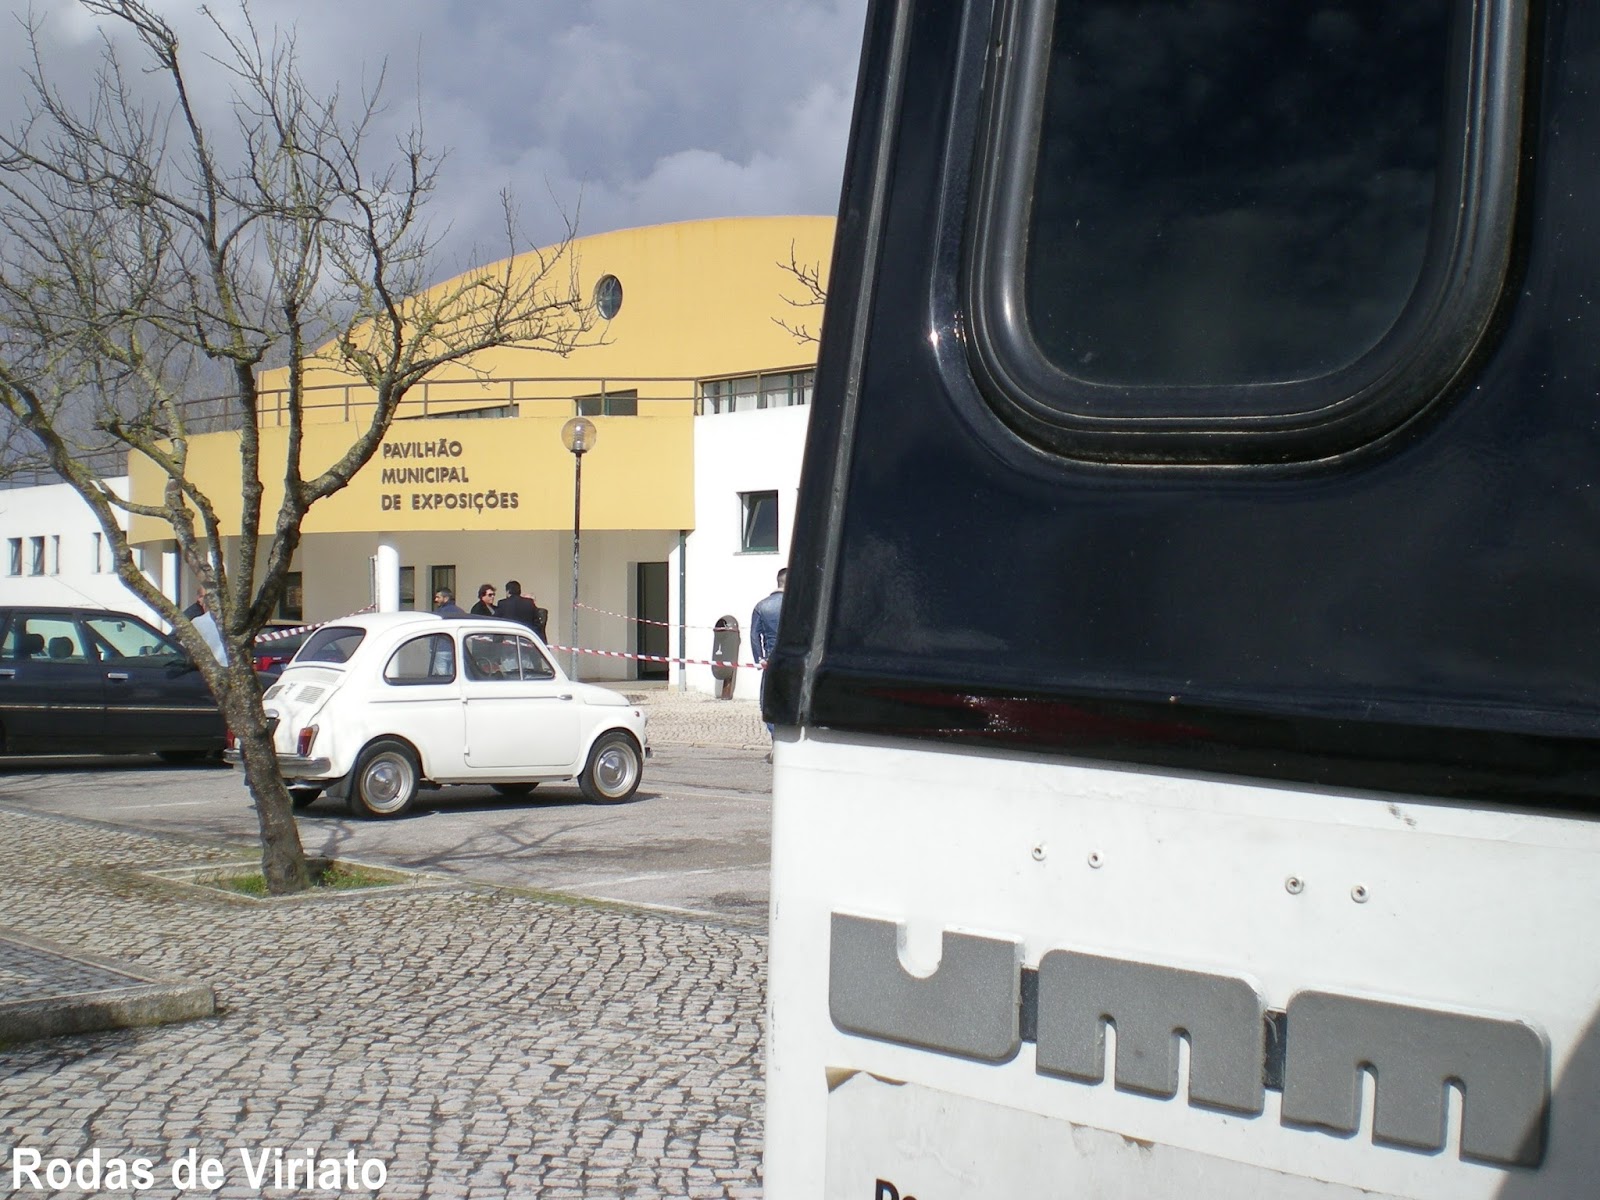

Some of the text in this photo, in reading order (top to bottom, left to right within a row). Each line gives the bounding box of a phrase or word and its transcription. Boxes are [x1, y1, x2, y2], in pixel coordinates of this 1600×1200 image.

[382, 438, 463, 459] PAVILHÃO
[381, 466, 469, 484] MUNICIPAL
[381, 489, 519, 514] DE EXPOSIÇÕES
